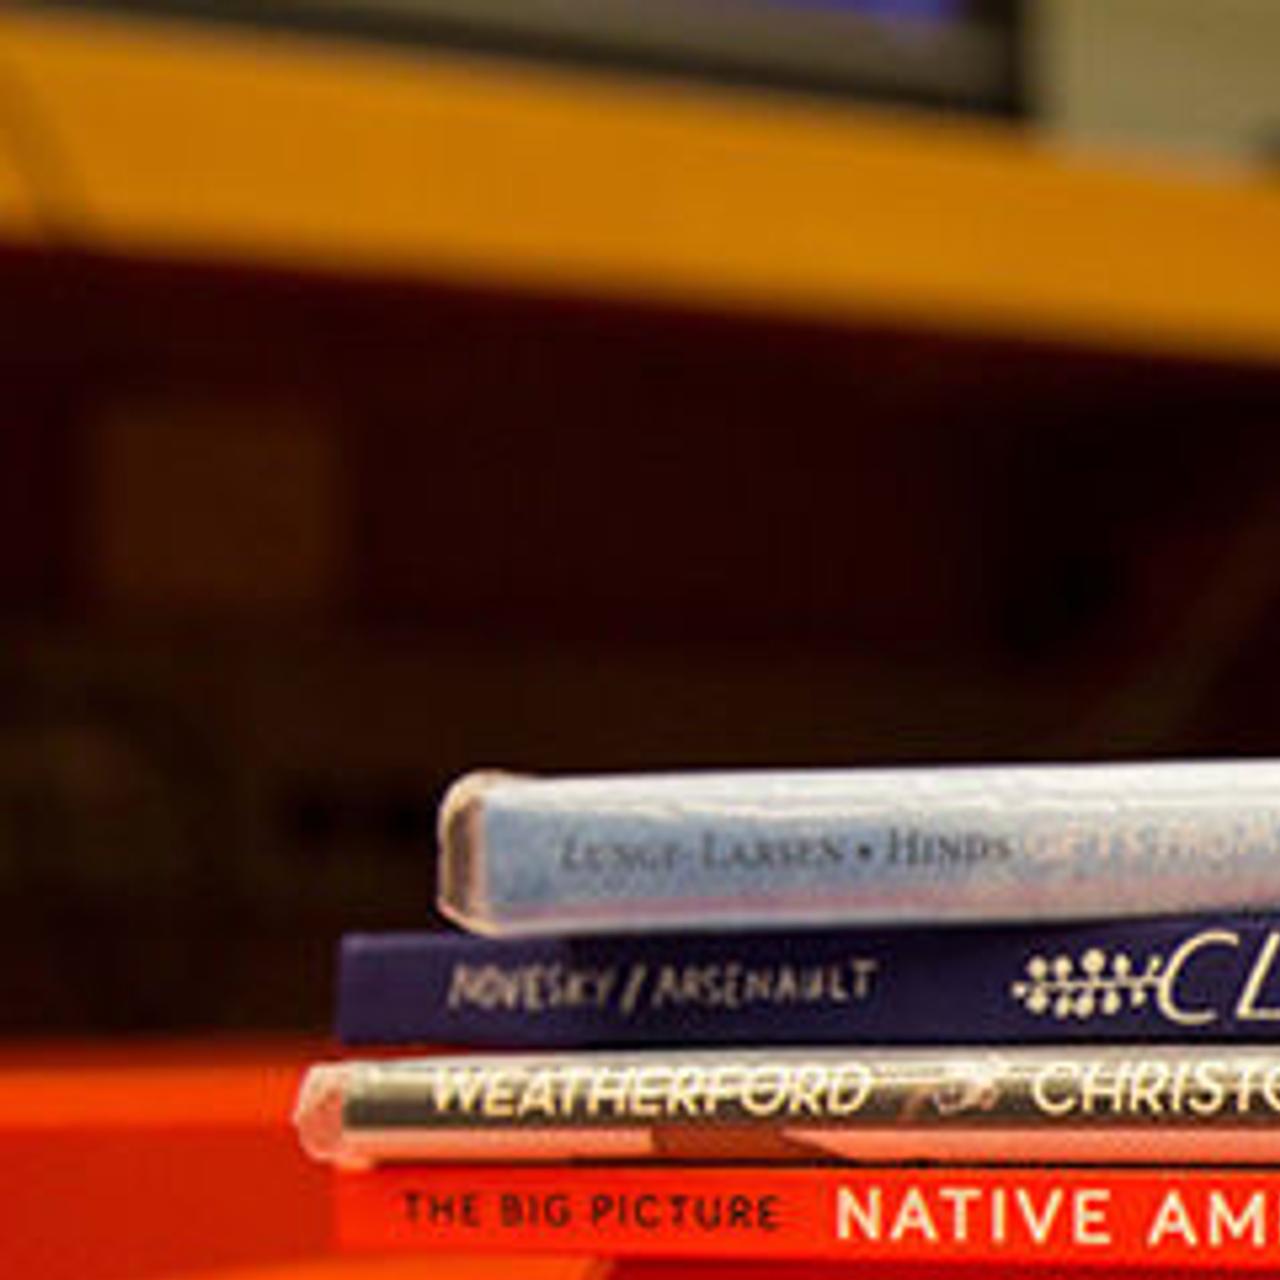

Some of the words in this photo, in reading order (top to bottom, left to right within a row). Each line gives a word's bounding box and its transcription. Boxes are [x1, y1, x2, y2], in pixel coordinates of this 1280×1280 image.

[430, 1064, 874, 1118] WEATHERFORD
[404, 1192, 482, 1228] THE
[500, 1192, 572, 1230] BIG
[590, 1194, 781, 1232] PICTURE
[835, 1184, 1112, 1246] NATIVE
